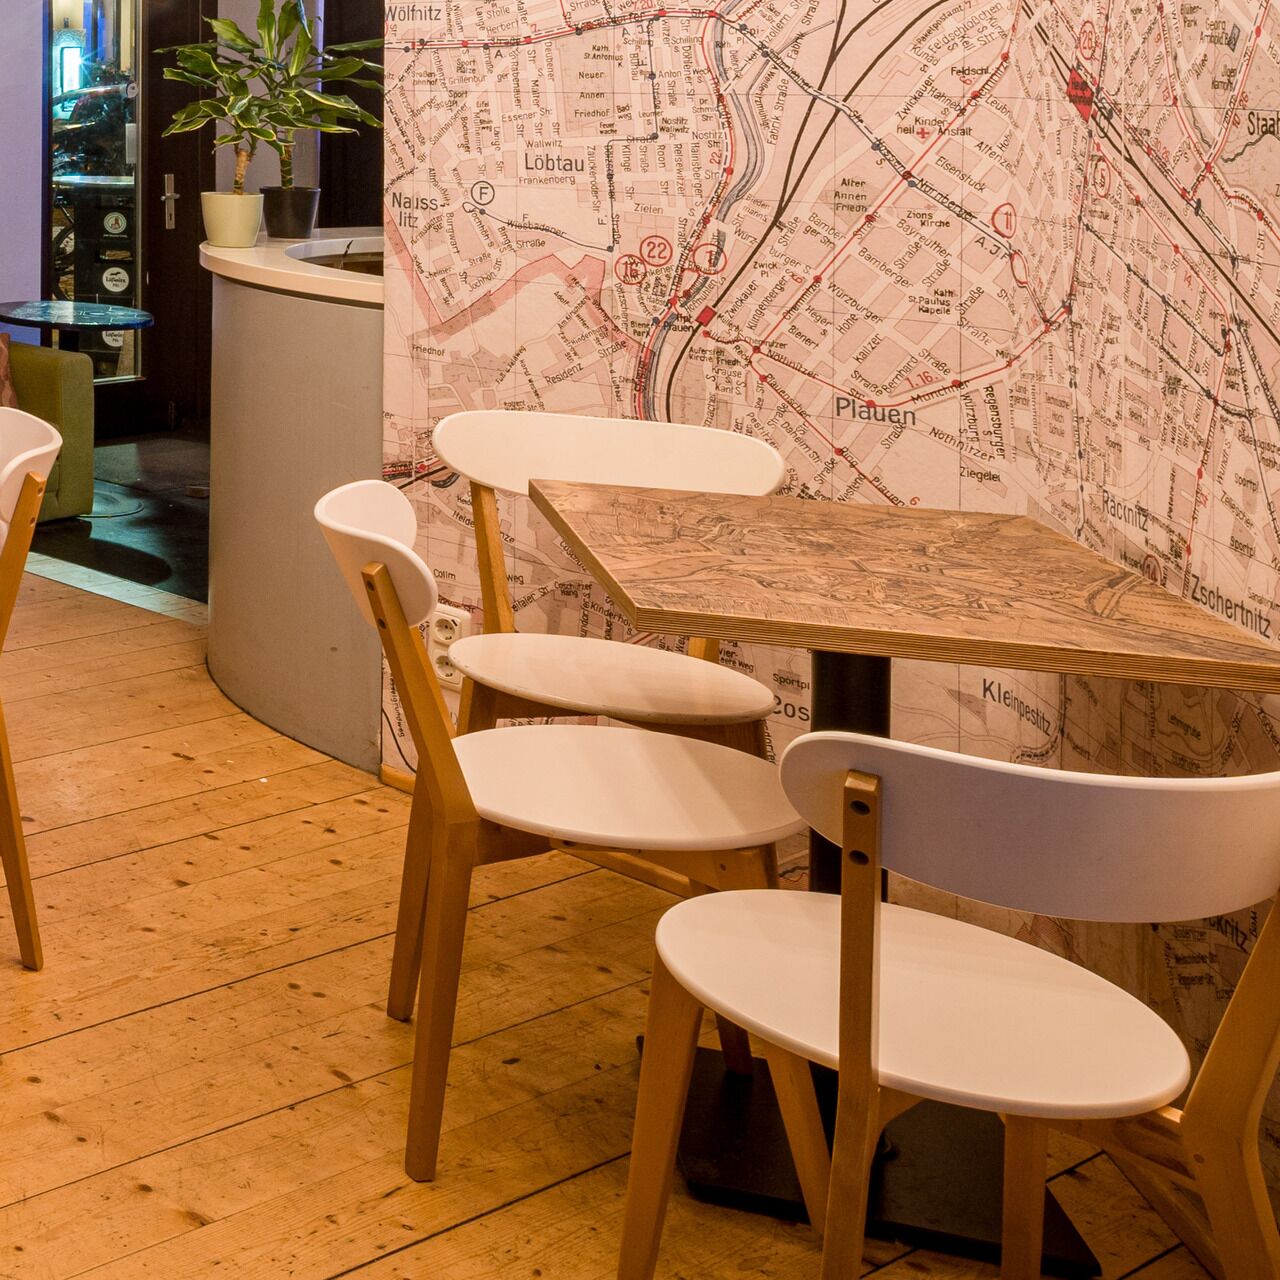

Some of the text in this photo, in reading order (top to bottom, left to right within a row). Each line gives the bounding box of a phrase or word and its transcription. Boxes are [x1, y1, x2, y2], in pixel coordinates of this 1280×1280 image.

[384, 6, 441, 21] Wölfnitz
[578, 71, 604, 79] Neuer
[579, 91, 605, 100] Annen
[574, 109, 610, 118] Friedhof
[938, 126, 973, 136] Anstalt
[526, 139, 563, 149] Wallwitz
[524, 152, 585, 172] Löbtau
[519, 174, 576, 185] Frankenberg
[920, 219, 950, 228] Kirche
[516, 239, 546, 249] Straße
[545, 363, 583, 385] Residenz
[836, 397, 916, 426] Plauen
[1191, 574, 1271, 639] Zschertnitz
[982, 678, 1050, 736] Kleinpestitz
